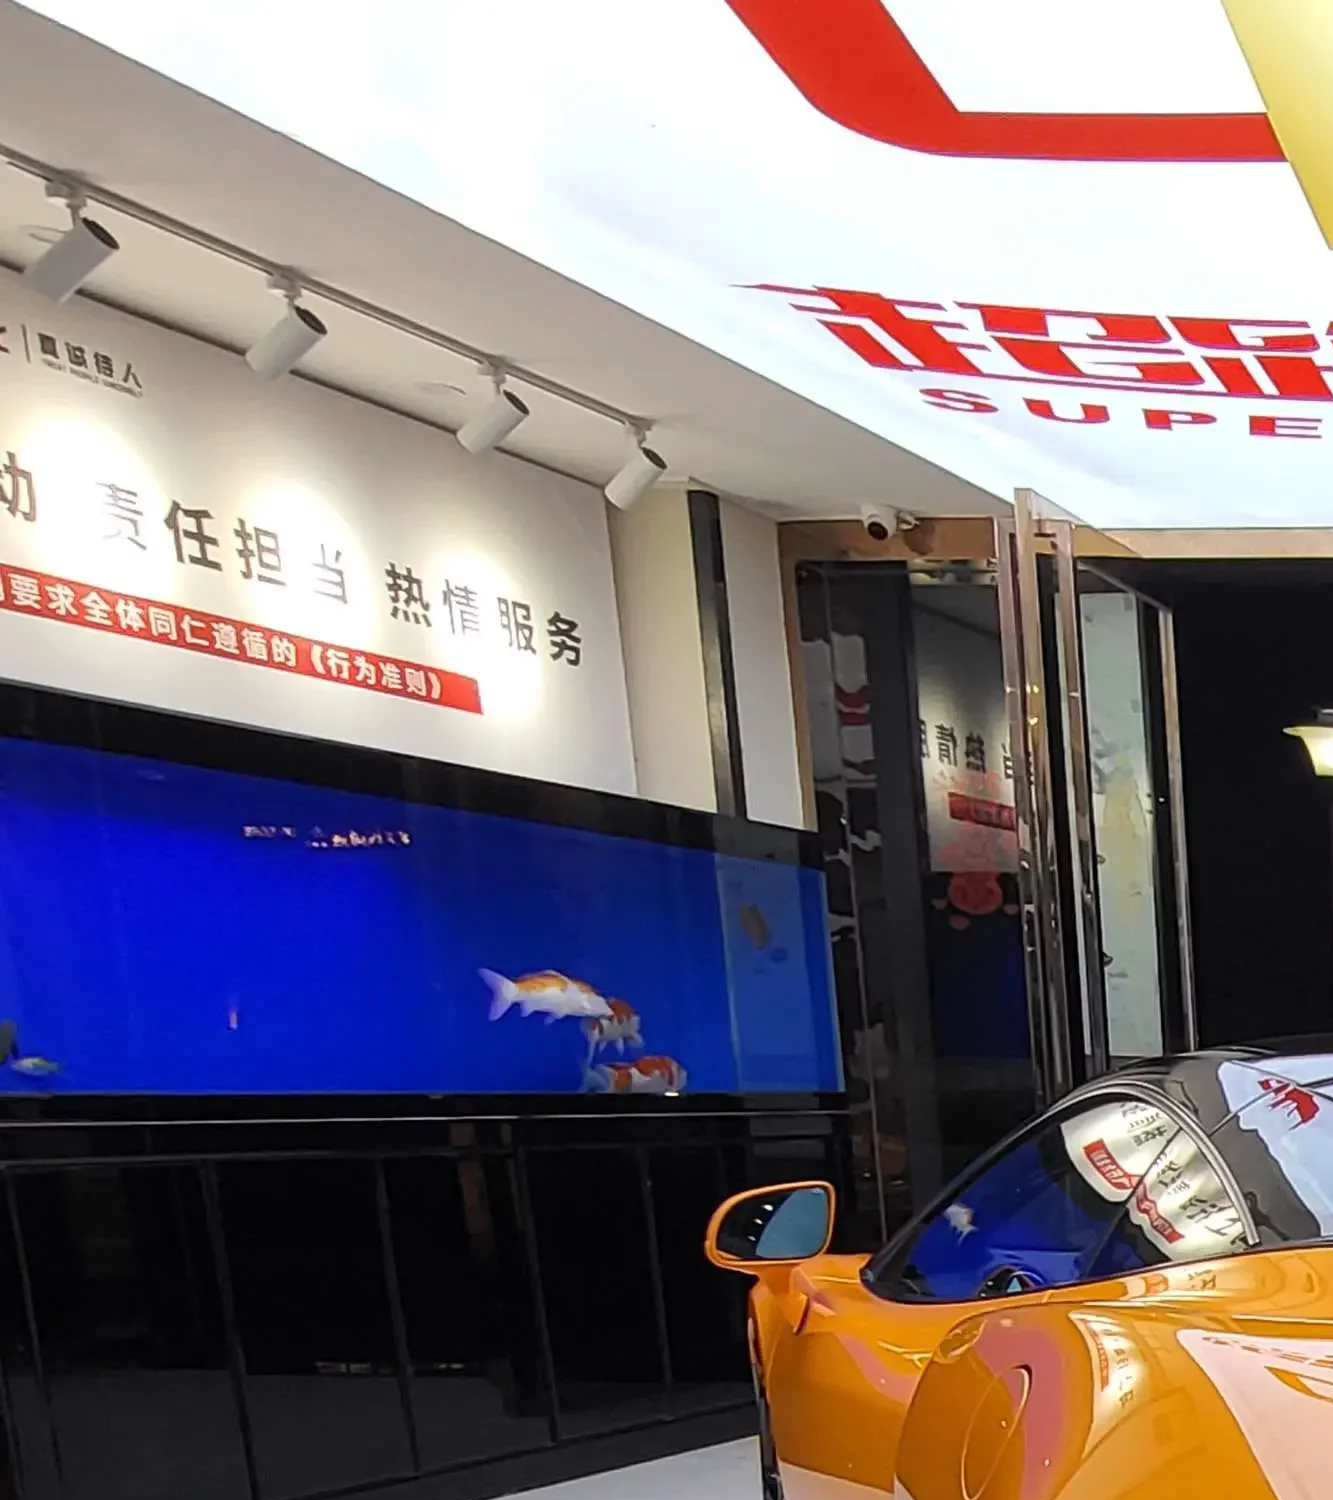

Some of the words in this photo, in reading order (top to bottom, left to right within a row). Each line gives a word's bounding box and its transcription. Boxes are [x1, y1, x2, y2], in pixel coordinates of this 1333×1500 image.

[0, 572, 443, 699] 要求全体同仁遵循的《行为准则》
[96, 480, 347, 604] 责任担当
[384, 562, 582, 667] 热情服务
